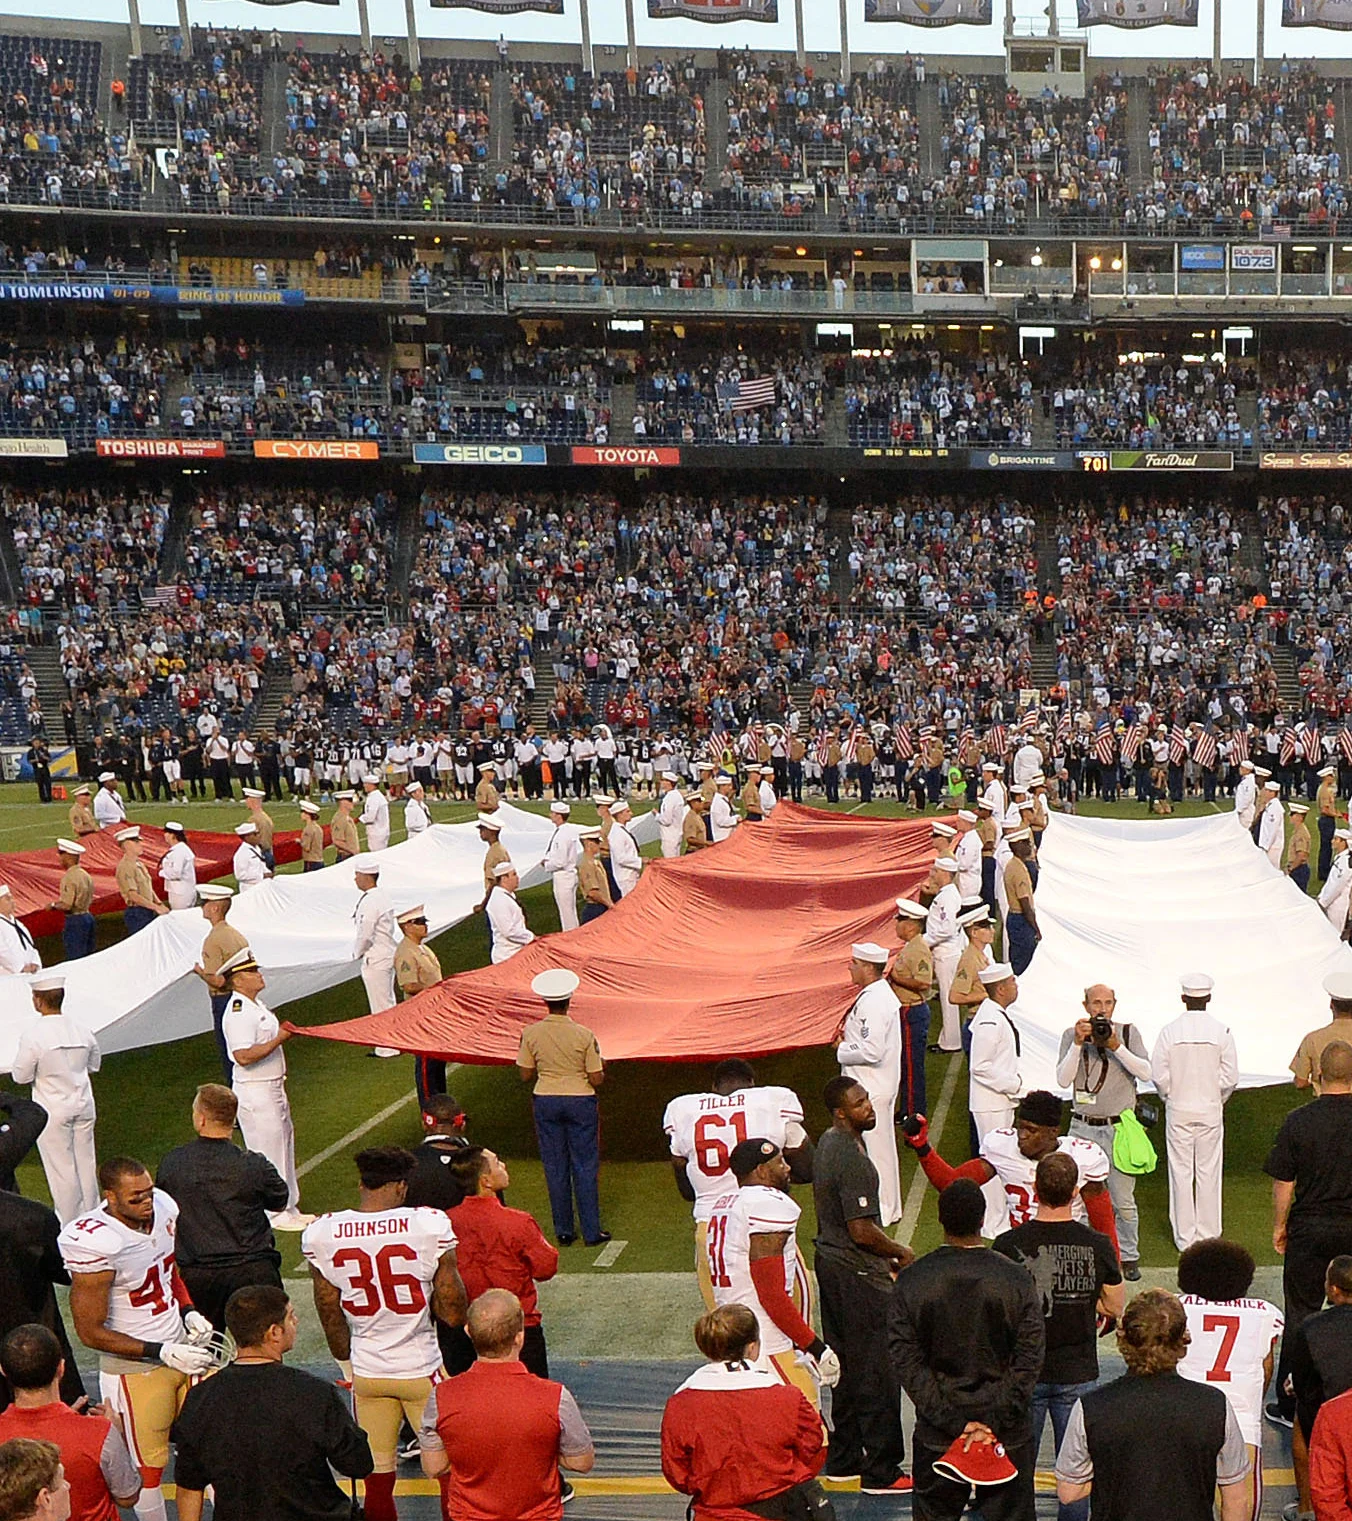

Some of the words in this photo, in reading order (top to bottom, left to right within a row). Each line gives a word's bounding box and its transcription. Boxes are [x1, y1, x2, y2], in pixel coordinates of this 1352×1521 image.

[10, 285, 105, 298] TOMLINSON
[178, 290, 212, 302] RING
[215, 291, 230, 302] OF
[235, 291, 282, 303] HONOR
[101, 441, 181, 456] TOSHIBA
[271, 442, 361, 458] CYMER
[444, 446, 523, 462] GEICO
[595, 449, 660, 463] TOYOTA
[999, 456, 1056, 465] BRIGANTINE
[1145, 454, 1198, 467] FanDuel
[699, 1094, 745, 1111] TILLER
[694, 1110, 747, 1177] 61
[75, 1218, 108, 1235] 47
[334, 1217, 409, 1239] JOHNSON
[707, 1215, 732, 1288] 31
[1047, 1244, 1095, 1261] MERGING
[1056, 1260, 1084, 1276] VETS
[1087, 1260, 1096, 1276] &
[332, 1244, 426, 1317] 36
[1052, 1276, 1097, 1291] PLAYERS
[1203, 1314, 1240, 1382] 7
